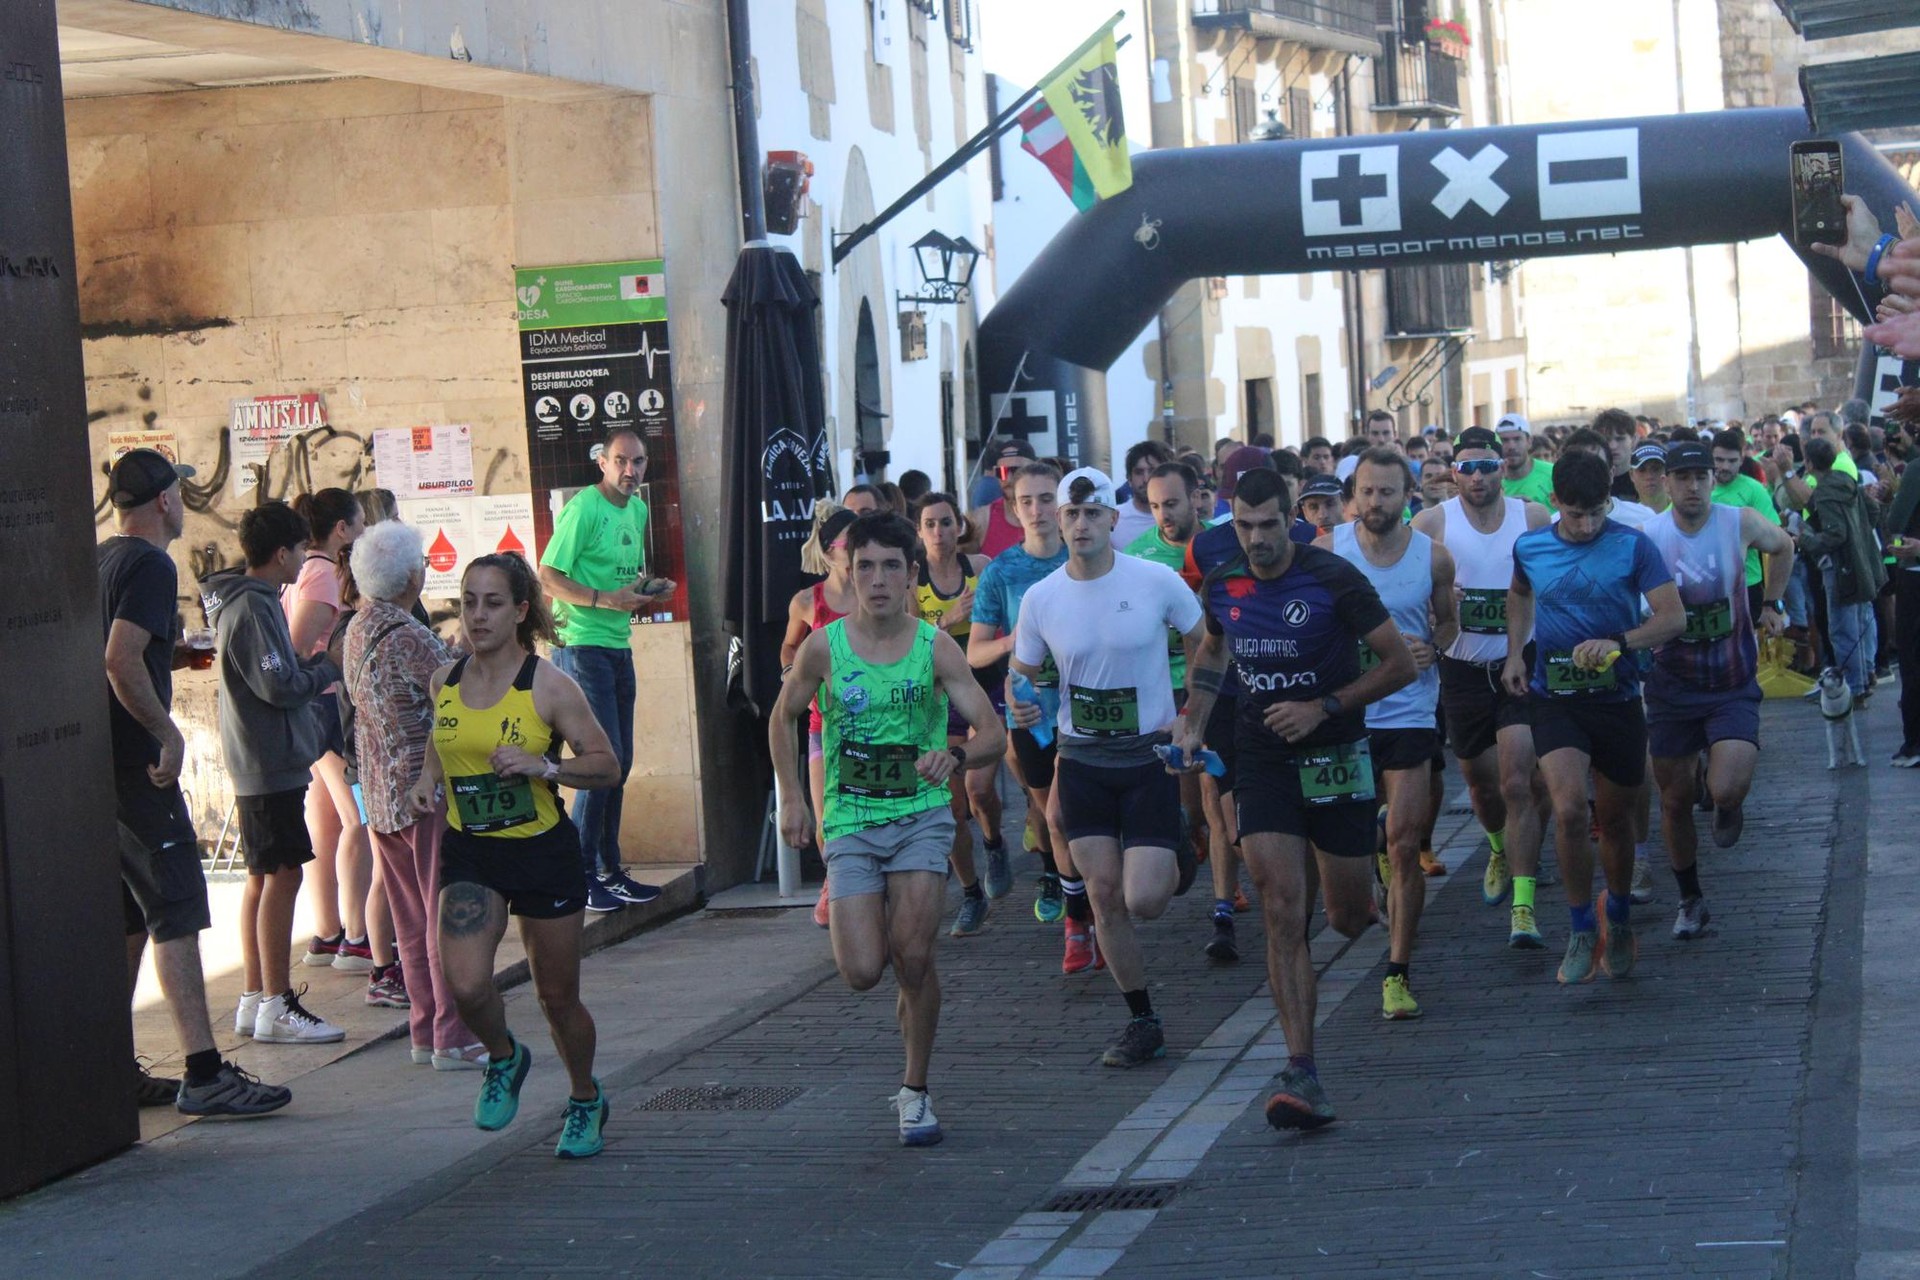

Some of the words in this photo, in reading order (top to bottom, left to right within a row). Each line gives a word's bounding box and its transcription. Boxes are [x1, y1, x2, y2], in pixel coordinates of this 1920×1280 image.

[1306, 224, 1644, 259] maspormenos.net
[519, 309, 549, 320] DESA
[529, 333, 558, 347] IDM
[560, 329, 606, 345] Medical
[529, 345, 573, 356] Equipación
[573, 342, 607, 352] Sanitaria
[530, 368, 610, 381] DESFIBRILADOREA
[531, 379, 594, 391] DESFIBRILADOR
[233, 402, 323, 430] AMNISTIA
[418, 480, 473, 490] USURBILGO
[1081, 704, 1124, 723] 399
[852, 761, 902, 782] 214
[1314, 763, 1362, 787] 404
[466, 790, 517, 816] 179
